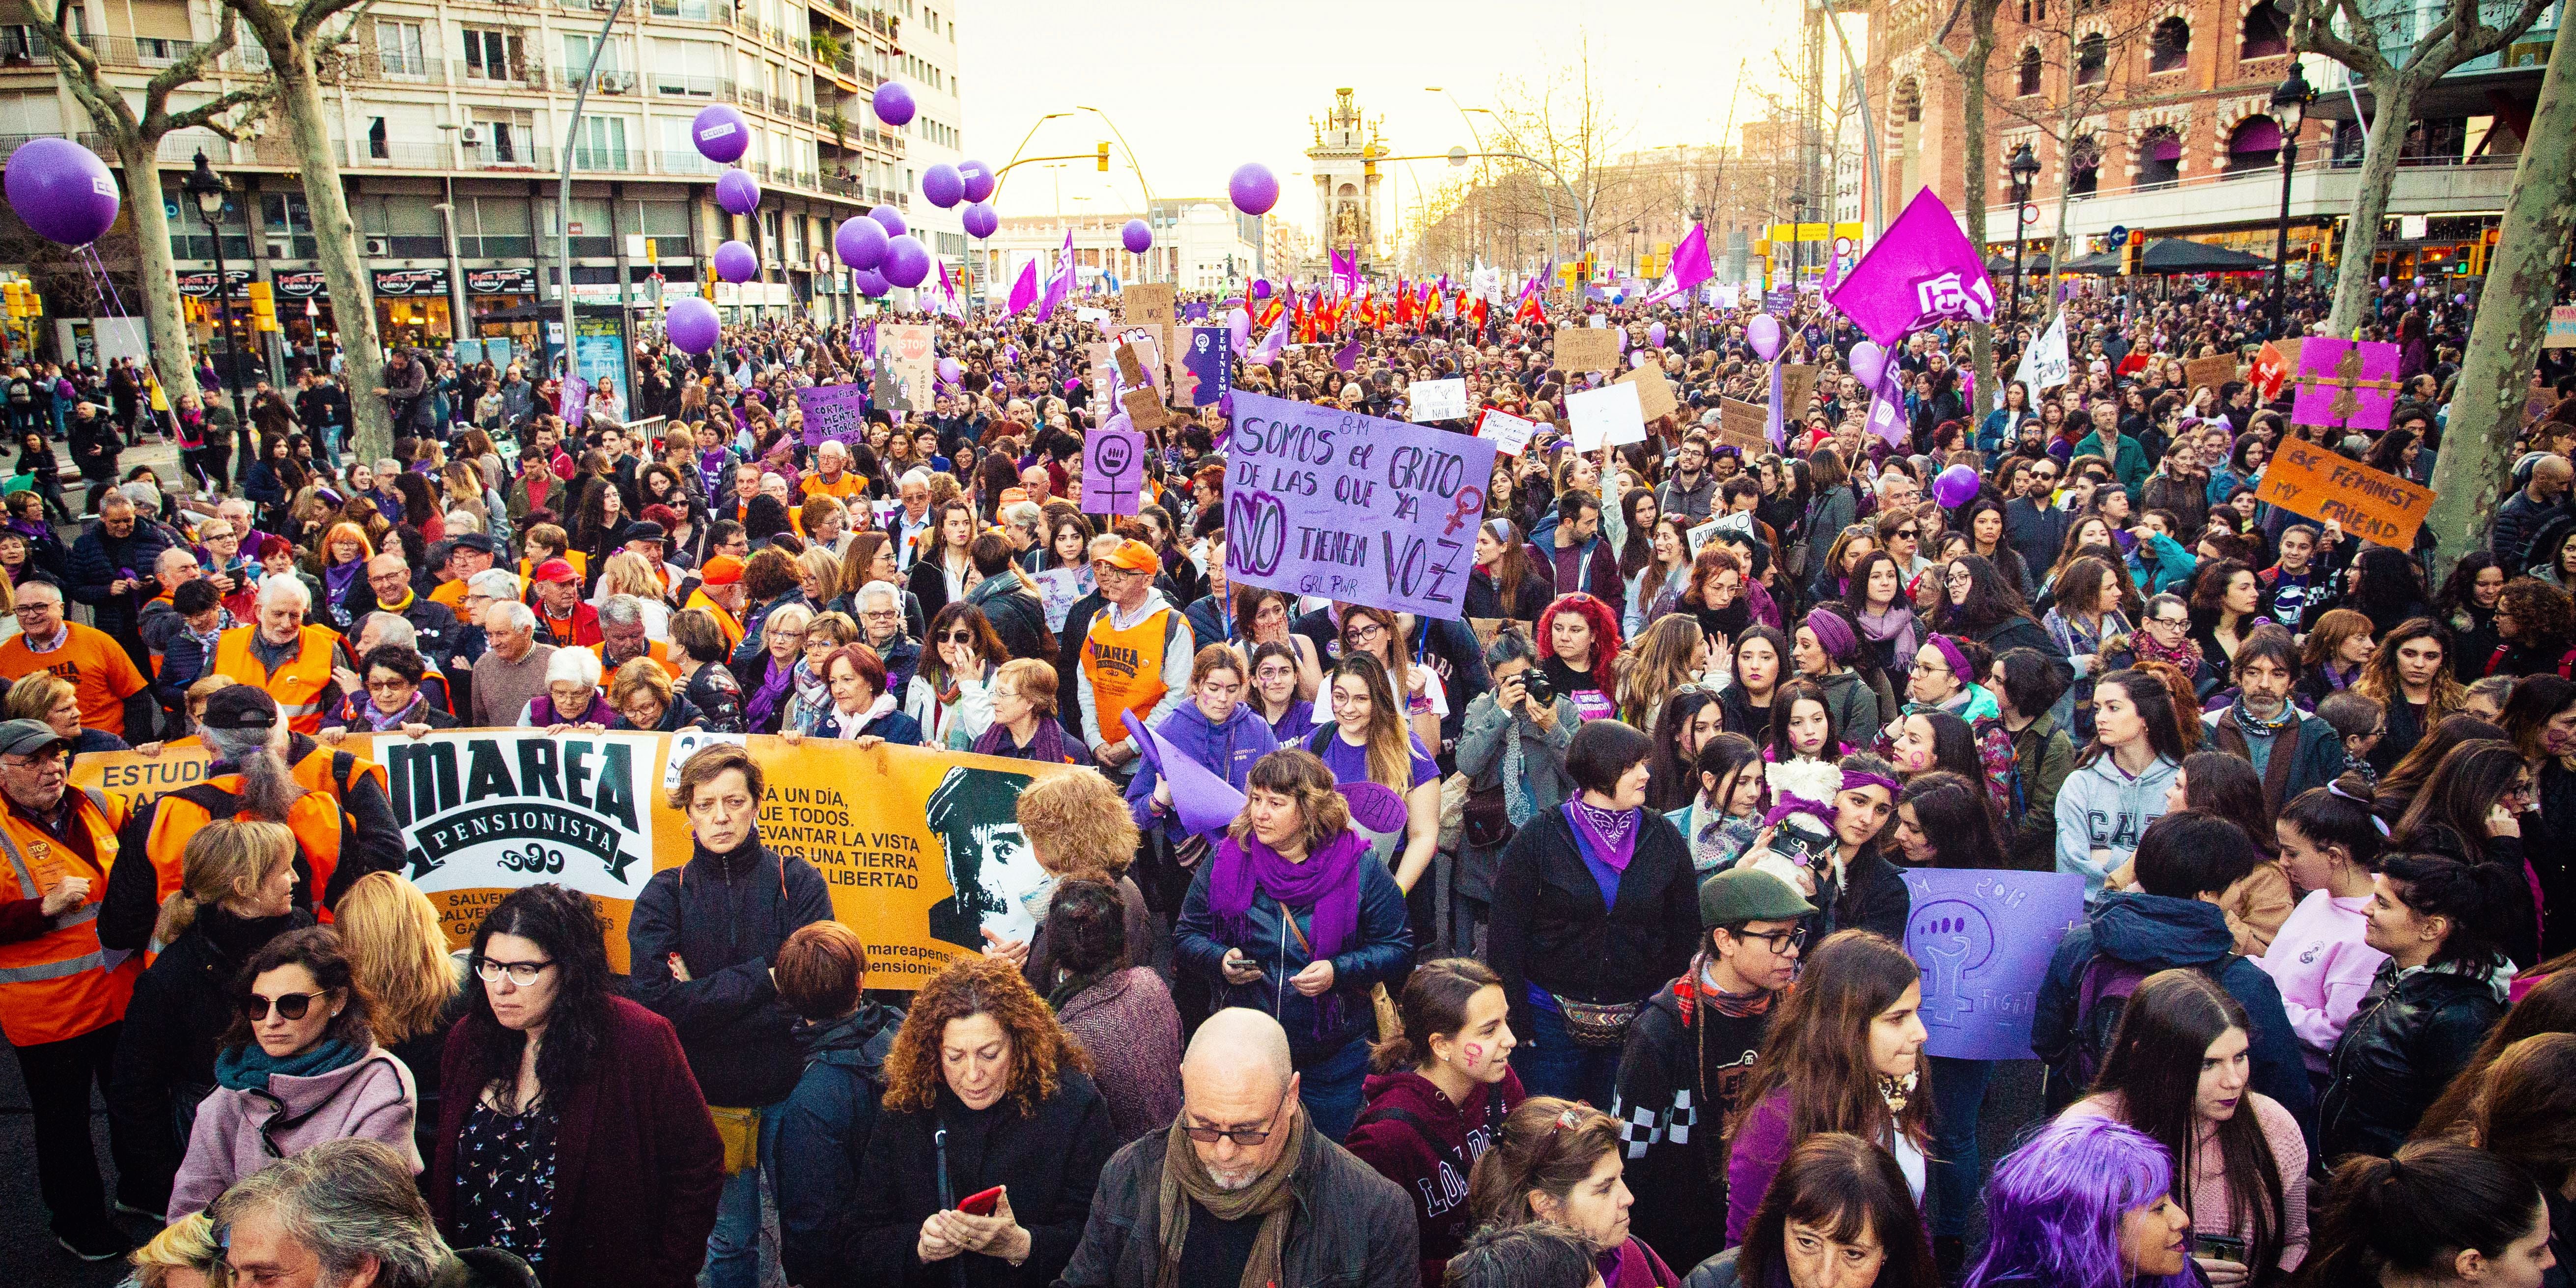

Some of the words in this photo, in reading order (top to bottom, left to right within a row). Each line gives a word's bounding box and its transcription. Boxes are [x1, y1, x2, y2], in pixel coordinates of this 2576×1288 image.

[900, 339, 926, 350] STOP
[800, 392, 809, 403] NO
[1094, 378, 1109, 416] PAZ
[815, 404, 844, 415] CORTA
[823, 410, 856, 425] MENTE
[1414, 403, 1425, 418] NO
[1432, 407, 1450, 419] NADIE
[1339, 416, 1370, 436] 8-M
[1236, 417, 1336, 466] SOMOS
[1348, 444, 1374, 470] el
[2287, 449, 2324, 472] BE
[2330, 465, 2421, 511] FEMINIST
[1236, 461, 1261, 488] DE
[1271, 467, 1318, 496] LAS
[1334, 475, 1377, 508] QUE
[1393, 491, 1419, 524] YA
[2273, 481, 2302, 501] MY
[1227, 494, 1283, 573] NO
[1382, 530, 1463, 604] VOZ
[1300, 575, 1325, 593] GRL
[1330, 575, 1359, 597] PWR
[47, 660, 81, 676] REA
[1576, 701, 1611, 712] PATRIARCHY
[1579, 694, 1600, 703] SMASH
[103, 759, 210, 788] ESTUDI
[387, 738, 640, 834] MAREA
[785, 787, 810, 804] UN
[815, 787, 849, 811] DÍA,
[758, 806, 784, 822] UE
[789, 807, 855, 827] TODOS.
[431, 812, 611, 852] PENSIONISTA
[759, 824, 837, 846] EVANTAR
[842, 831, 867, 848] LA
[871, 832, 921, 853] VISTA
[811, 847, 847, 866] UNA
[850, 851, 919, 872] TIERRA
[829, 868, 919, 890] LIBERTAD
[867, 944, 954, 963] mareapensi
